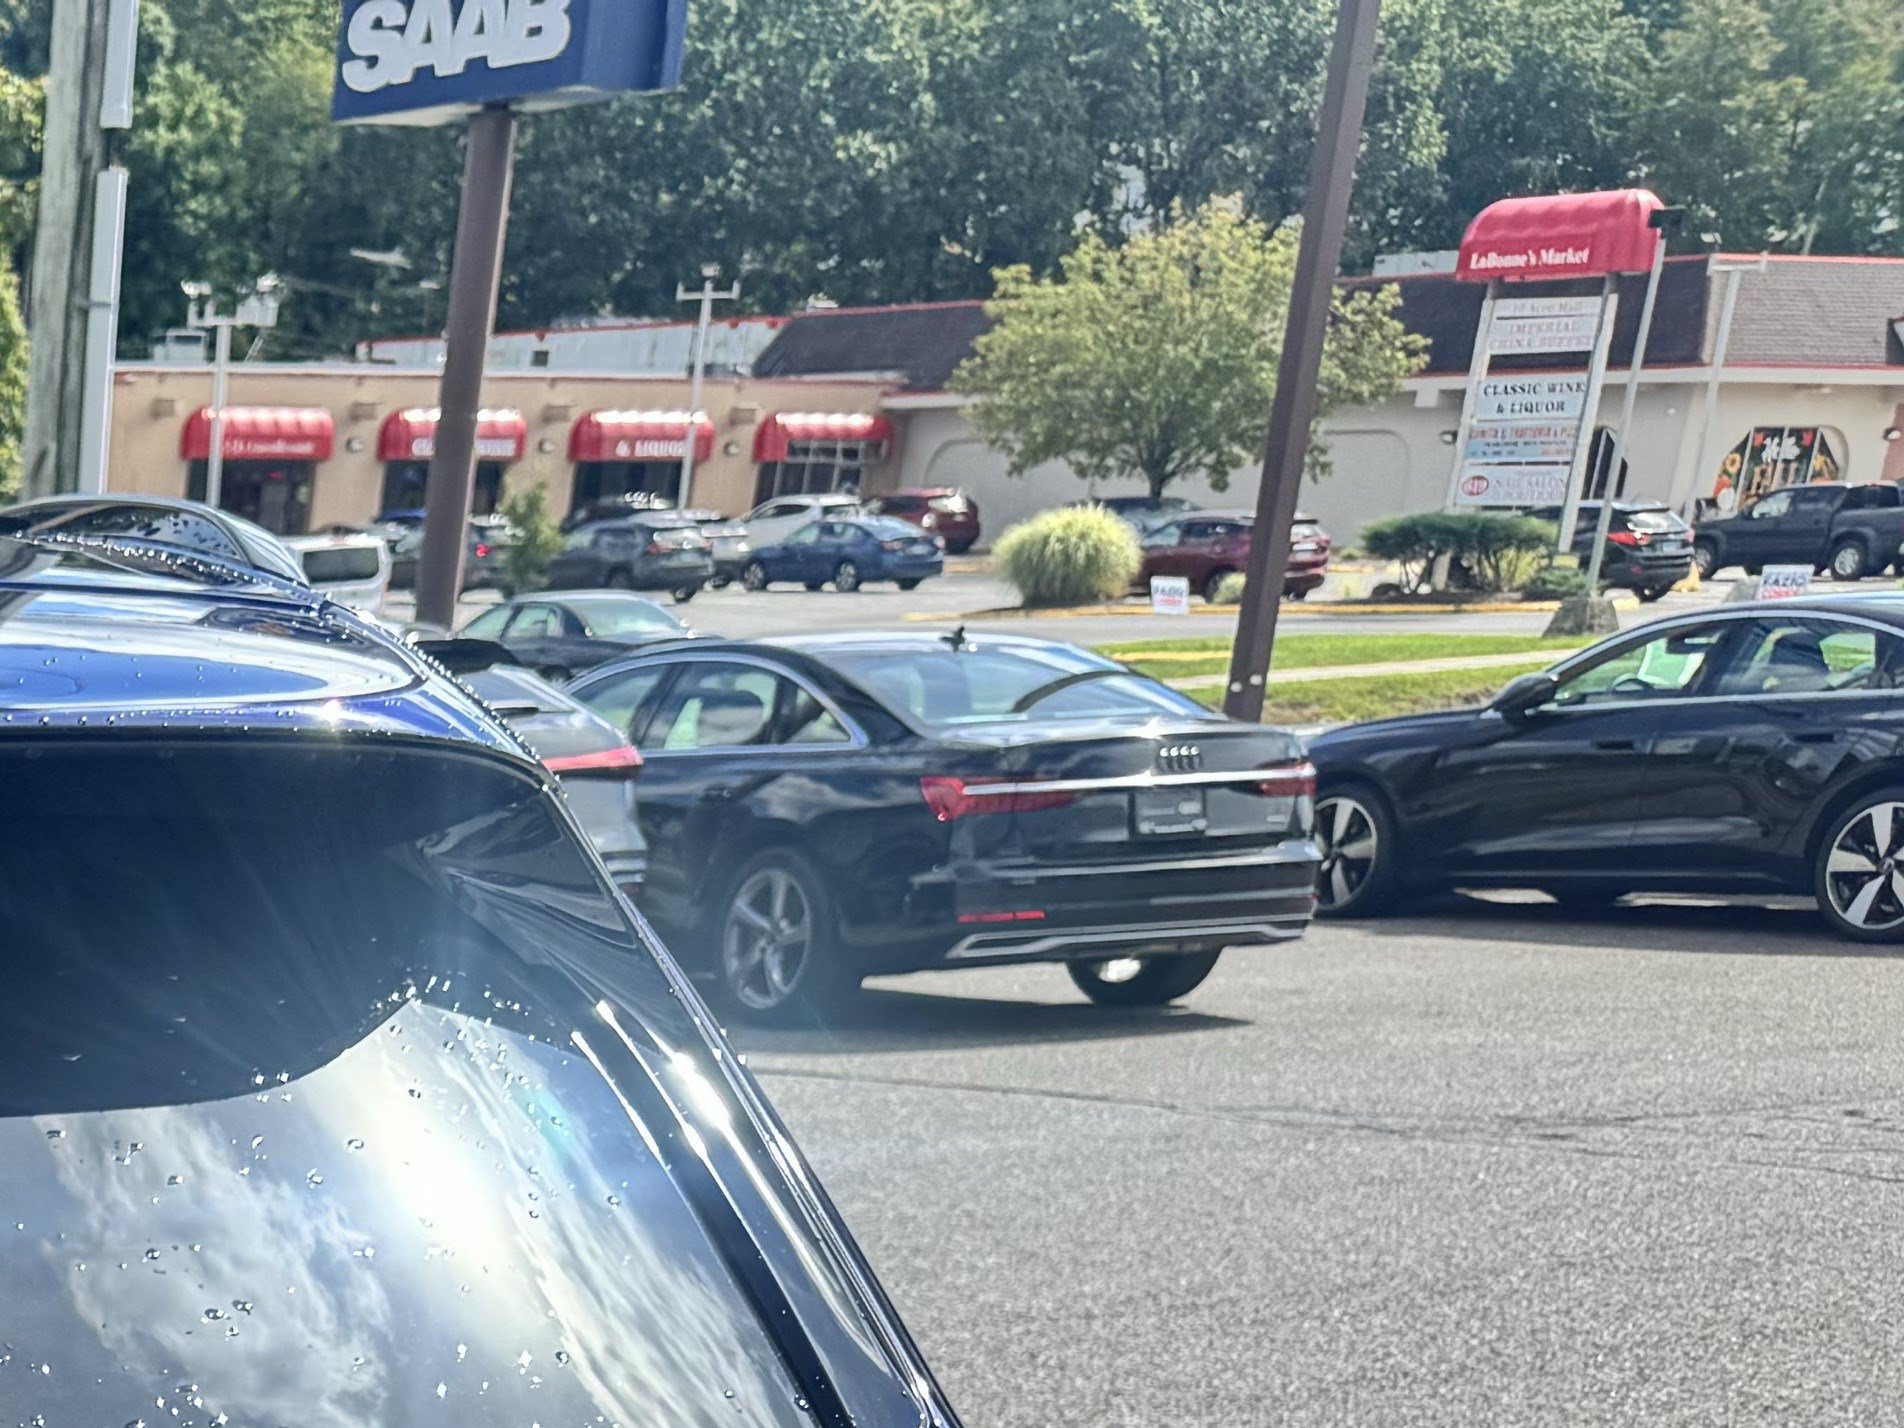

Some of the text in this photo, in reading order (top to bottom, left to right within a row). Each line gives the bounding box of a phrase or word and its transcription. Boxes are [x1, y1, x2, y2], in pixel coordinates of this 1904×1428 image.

[343, 0, 572, 93] SAAB
[1538, 247, 1590, 266] Market
[1483, 381, 1586, 397] CLASSIC WINE
[1510, 401, 1566, 414] LIQUOR
